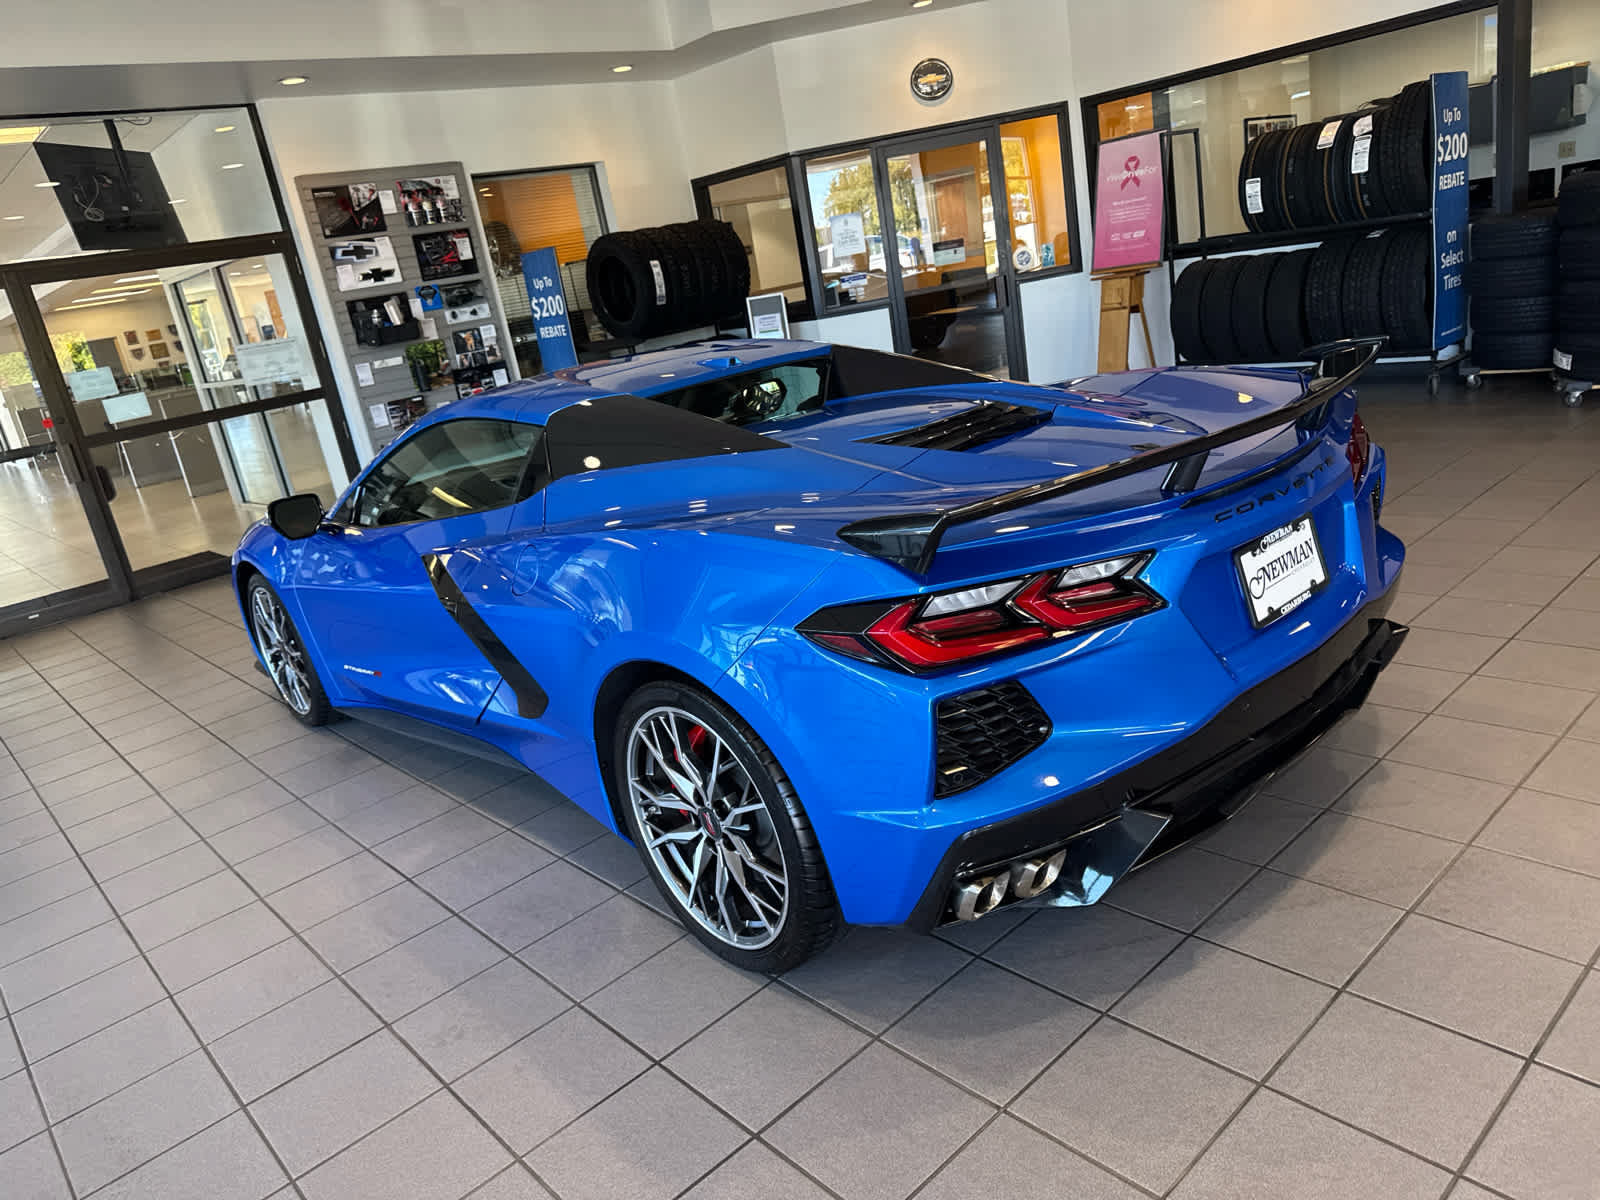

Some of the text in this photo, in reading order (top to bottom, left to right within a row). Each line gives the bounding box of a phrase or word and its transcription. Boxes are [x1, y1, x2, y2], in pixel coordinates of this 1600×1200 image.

[1443, 106, 1462, 127] Up To
[1438, 131, 1468, 166] $200
[1438, 170, 1465, 191] REBATE
[1446, 229, 1457, 244] on
[1440, 248, 1464, 270] Select
[532, 275, 553, 291] Up To
[1443, 273, 1463, 291] Tires
[530, 294, 564, 321] $200
[539, 324, 568, 339] REBATE
[1214, 456, 1334, 523] CORVETTE
[1249, 537, 1314, 600] NEWMAN
